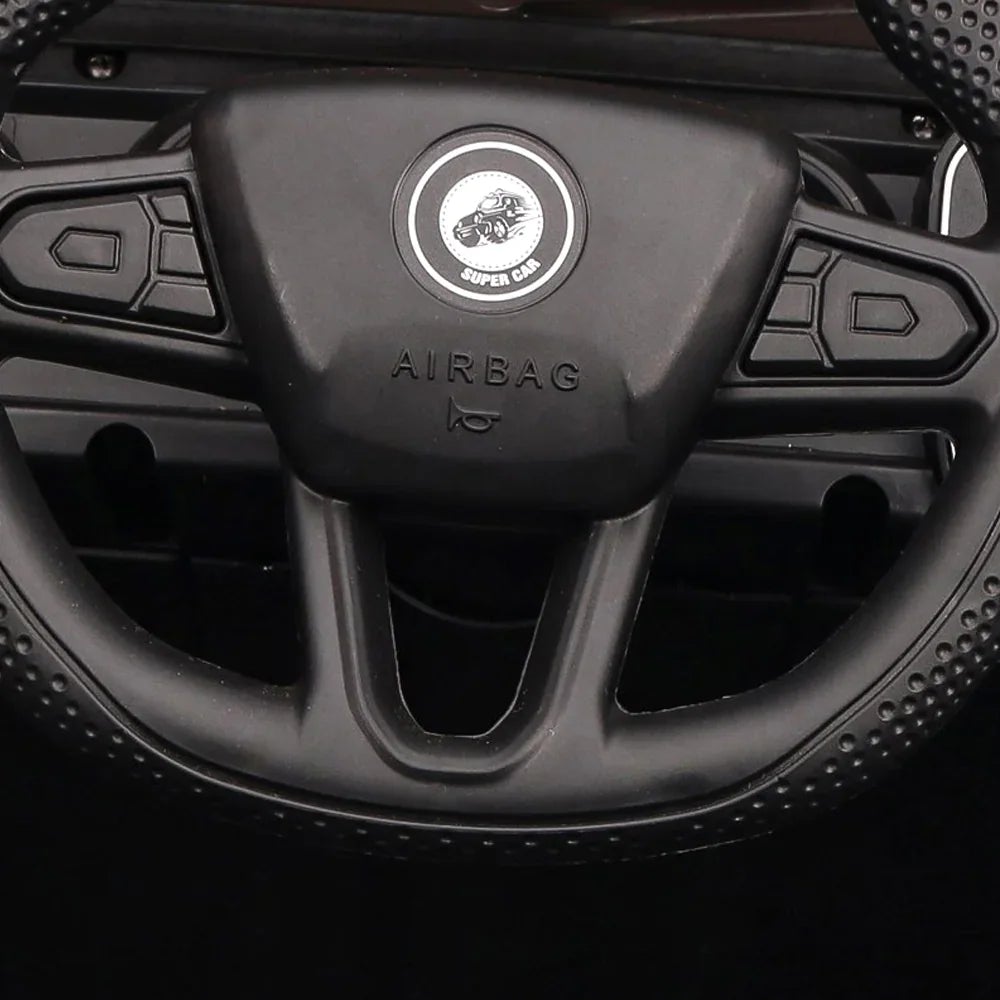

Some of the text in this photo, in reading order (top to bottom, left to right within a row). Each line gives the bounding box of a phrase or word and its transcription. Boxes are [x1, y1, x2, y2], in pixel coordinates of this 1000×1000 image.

[460, 257, 542, 288] SUPER CAR
[391, 347, 581, 392] AIRBAG
